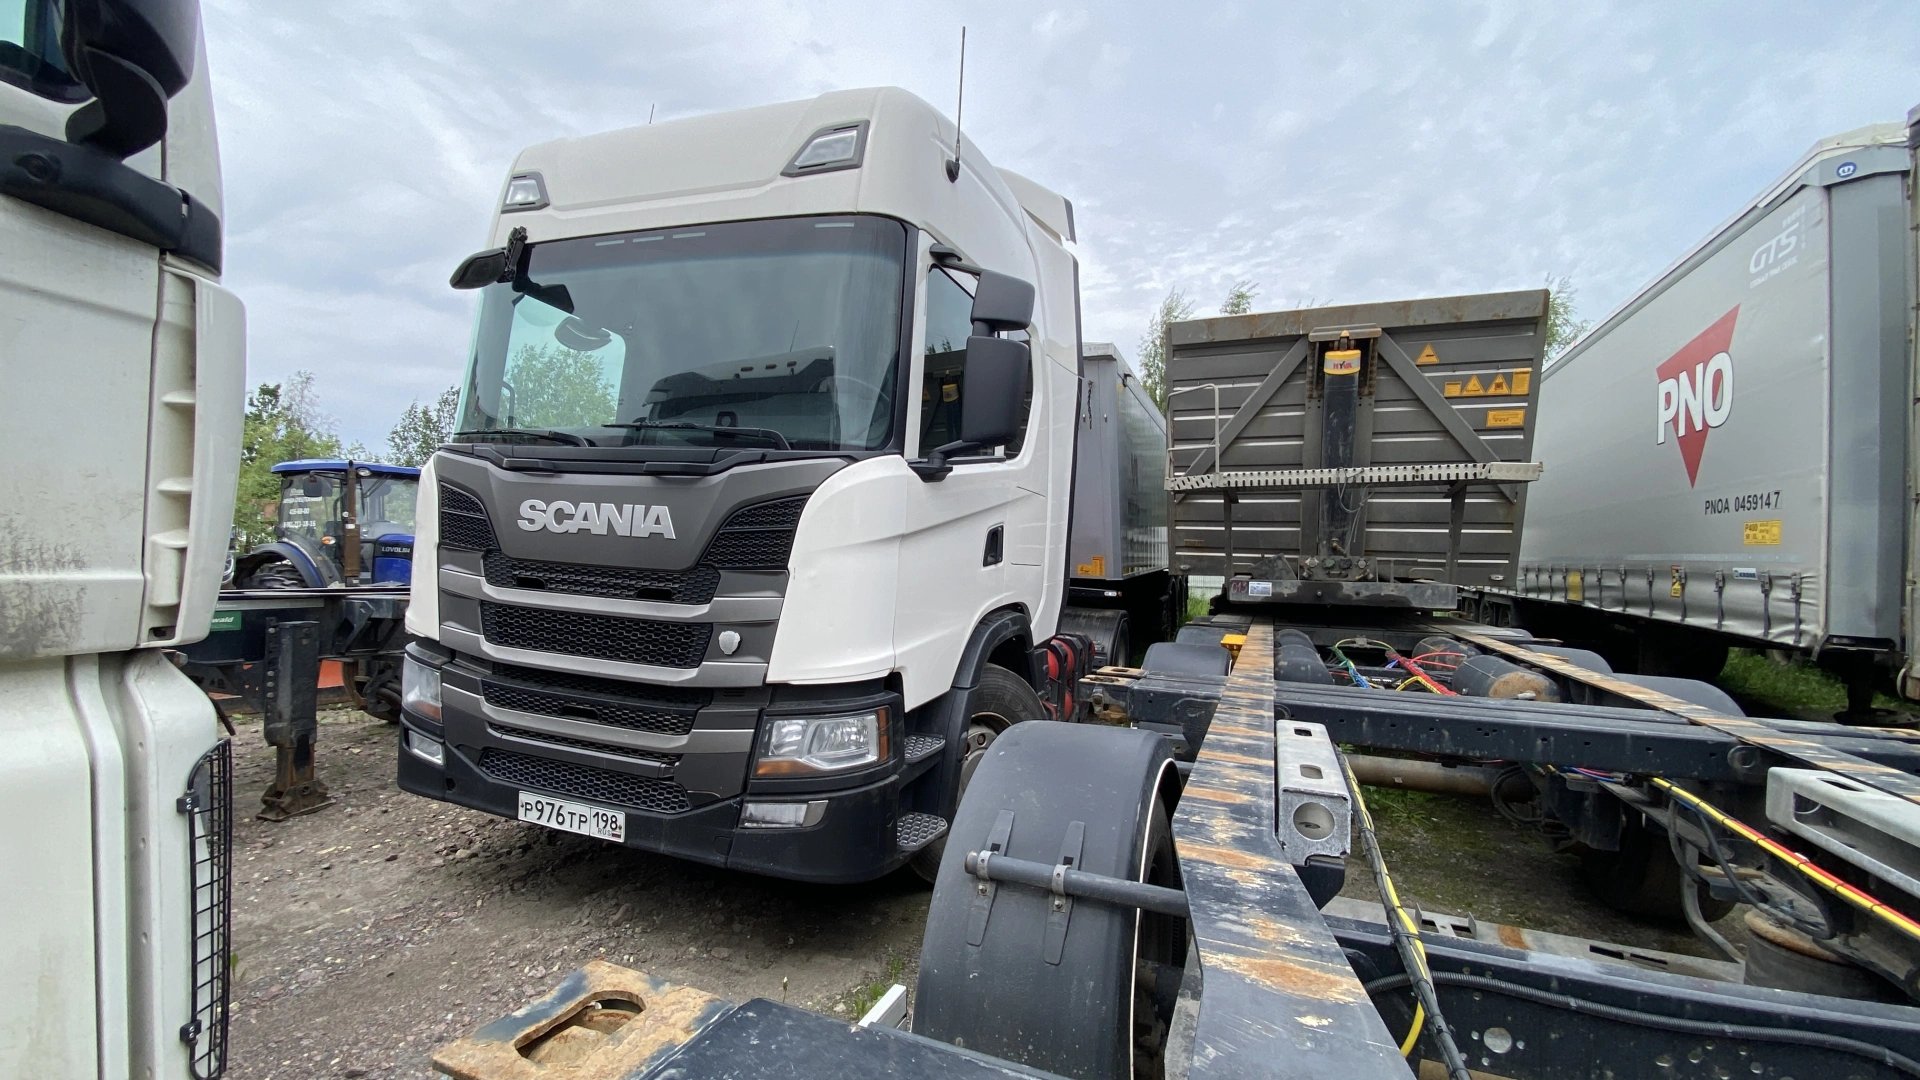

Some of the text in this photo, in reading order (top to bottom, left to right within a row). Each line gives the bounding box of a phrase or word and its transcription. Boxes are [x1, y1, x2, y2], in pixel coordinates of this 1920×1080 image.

[1749, 221, 1799, 274] GTS
[1656, 351, 1734, 446] PNO
[516, 499, 677, 540] SCANIA
[1704, 491, 1781, 516] PNOA 0459147
[592, 811, 618, 831] 198
